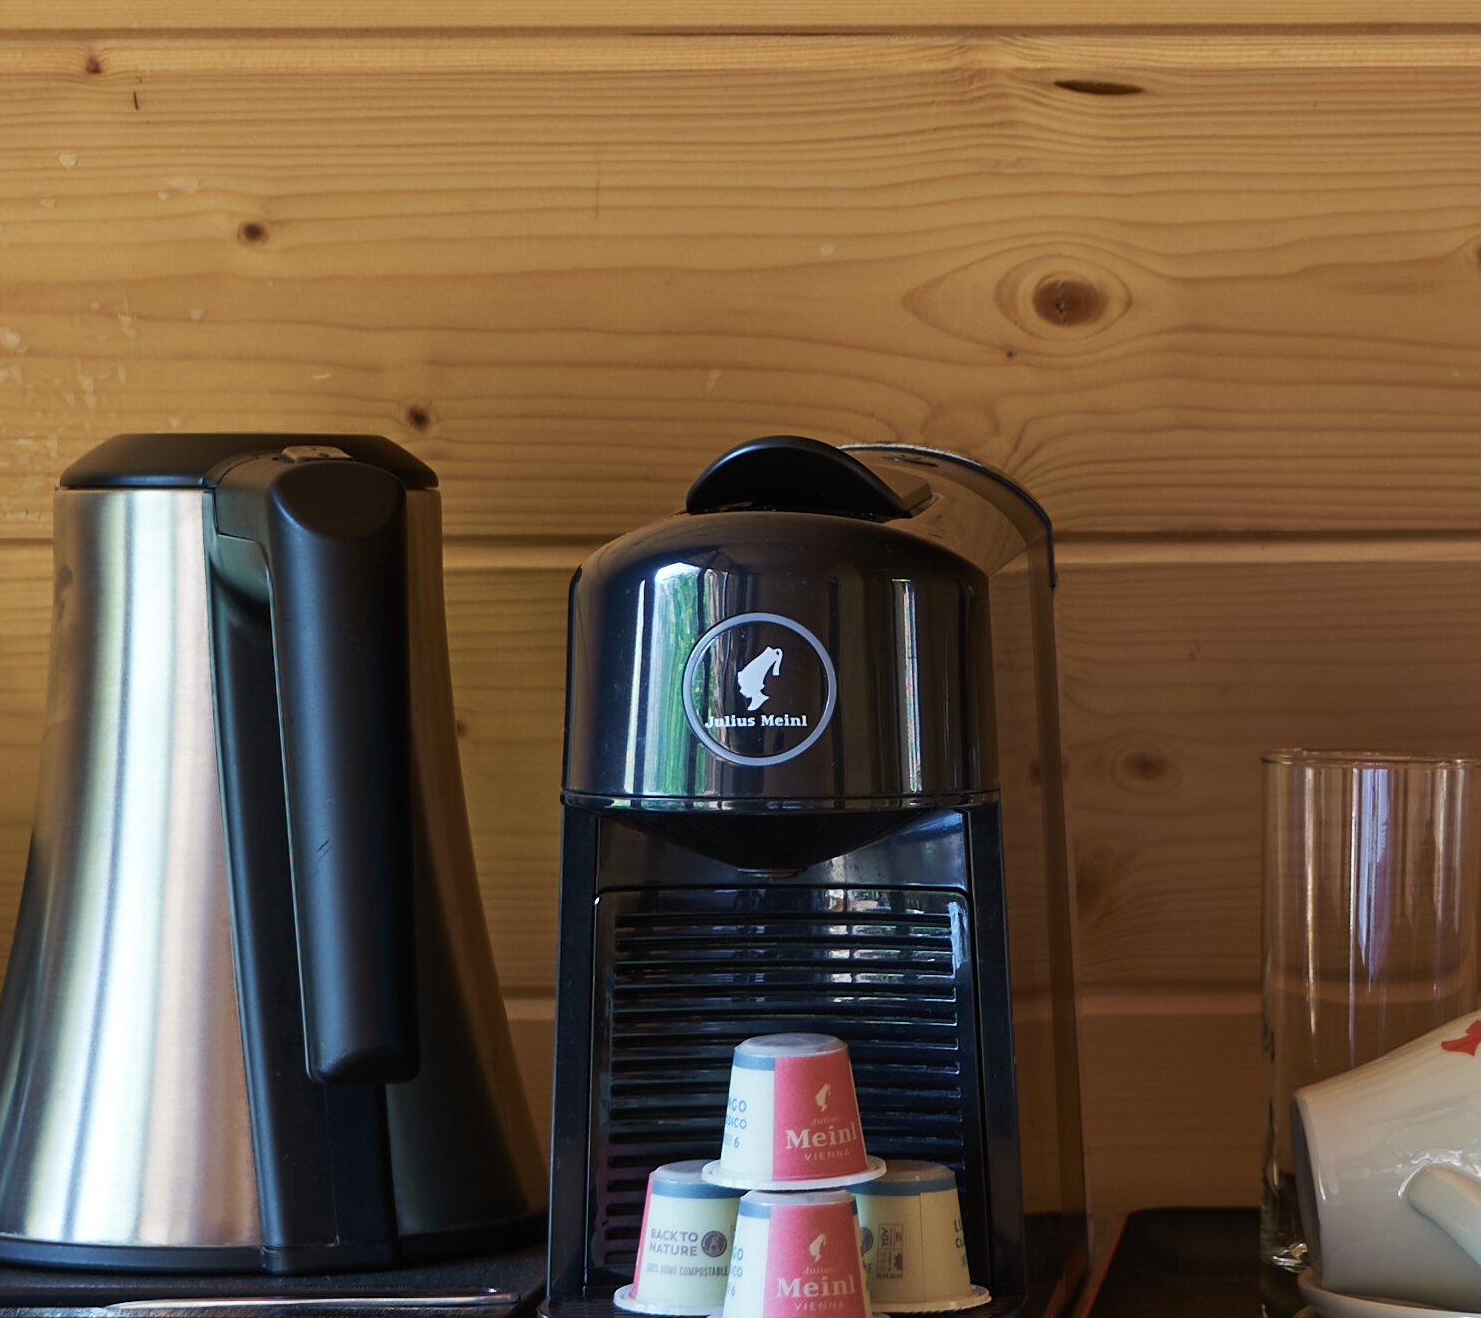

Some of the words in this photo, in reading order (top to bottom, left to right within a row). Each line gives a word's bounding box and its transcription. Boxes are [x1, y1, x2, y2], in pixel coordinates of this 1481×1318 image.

[705, 714, 756, 728] Julius
[761, 713, 808, 727] Meinl
[784, 1122, 857, 1150] Meinl
[804, 1148, 851, 1161] VIENNA
[650, 1228, 677, 1242] BACK
[680, 1231, 699, 1242] TO
[649, 1242, 698, 1257] NATURE
[775, 1275, 856, 1298] Meinl
[794, 1302, 846, 1312] VIENNA
